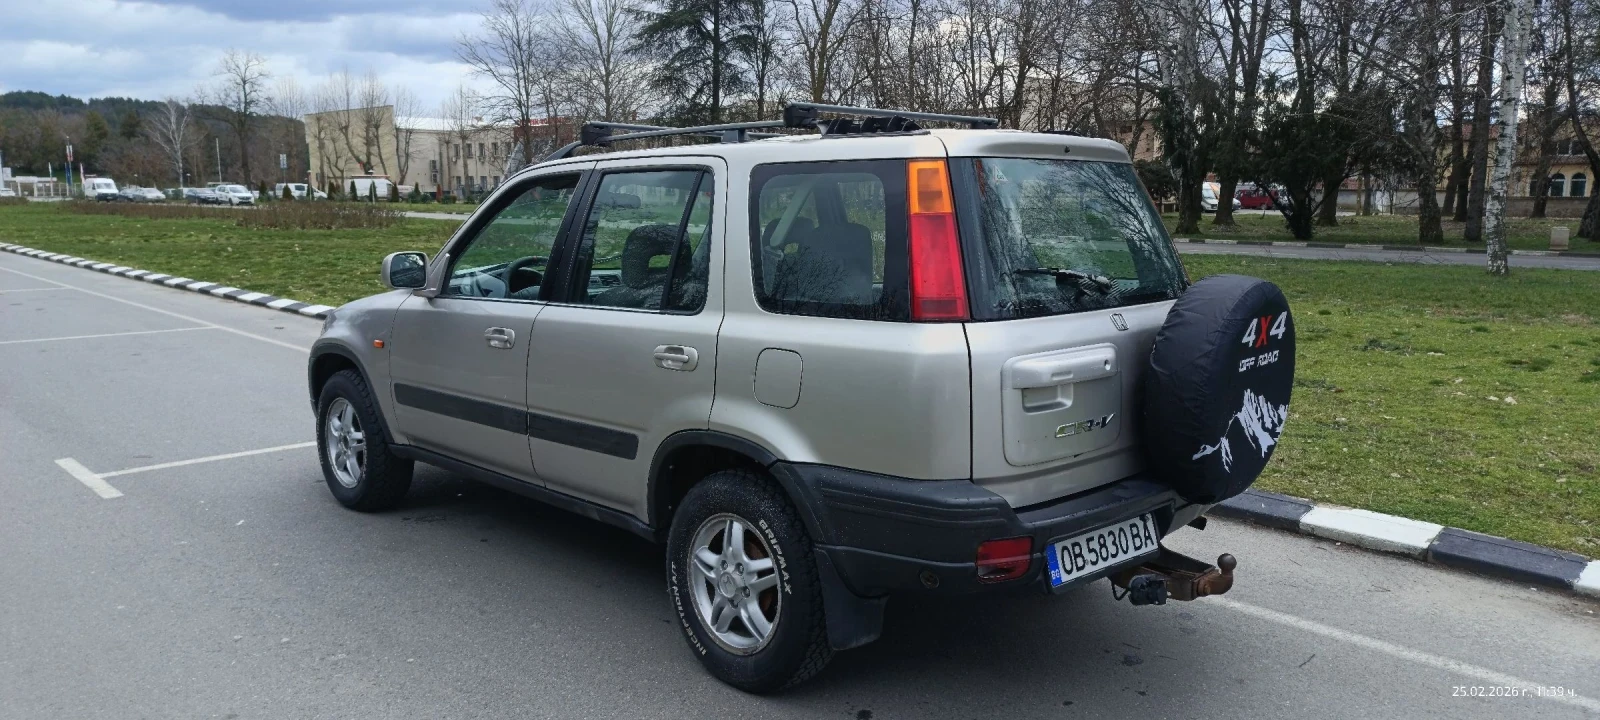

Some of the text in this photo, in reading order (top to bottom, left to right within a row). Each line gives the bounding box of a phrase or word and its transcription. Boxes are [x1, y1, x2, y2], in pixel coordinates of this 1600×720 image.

[1242, 311, 1287, 347] 4X4
[1239, 350, 1279, 372] OFF ROAD
[1055, 413, 1116, 438] CR-V
[759, 519, 792, 594] GRIPMAX
[1051, 569, 1060, 580] BG
[672, 586, 707, 655] INCEPTION
